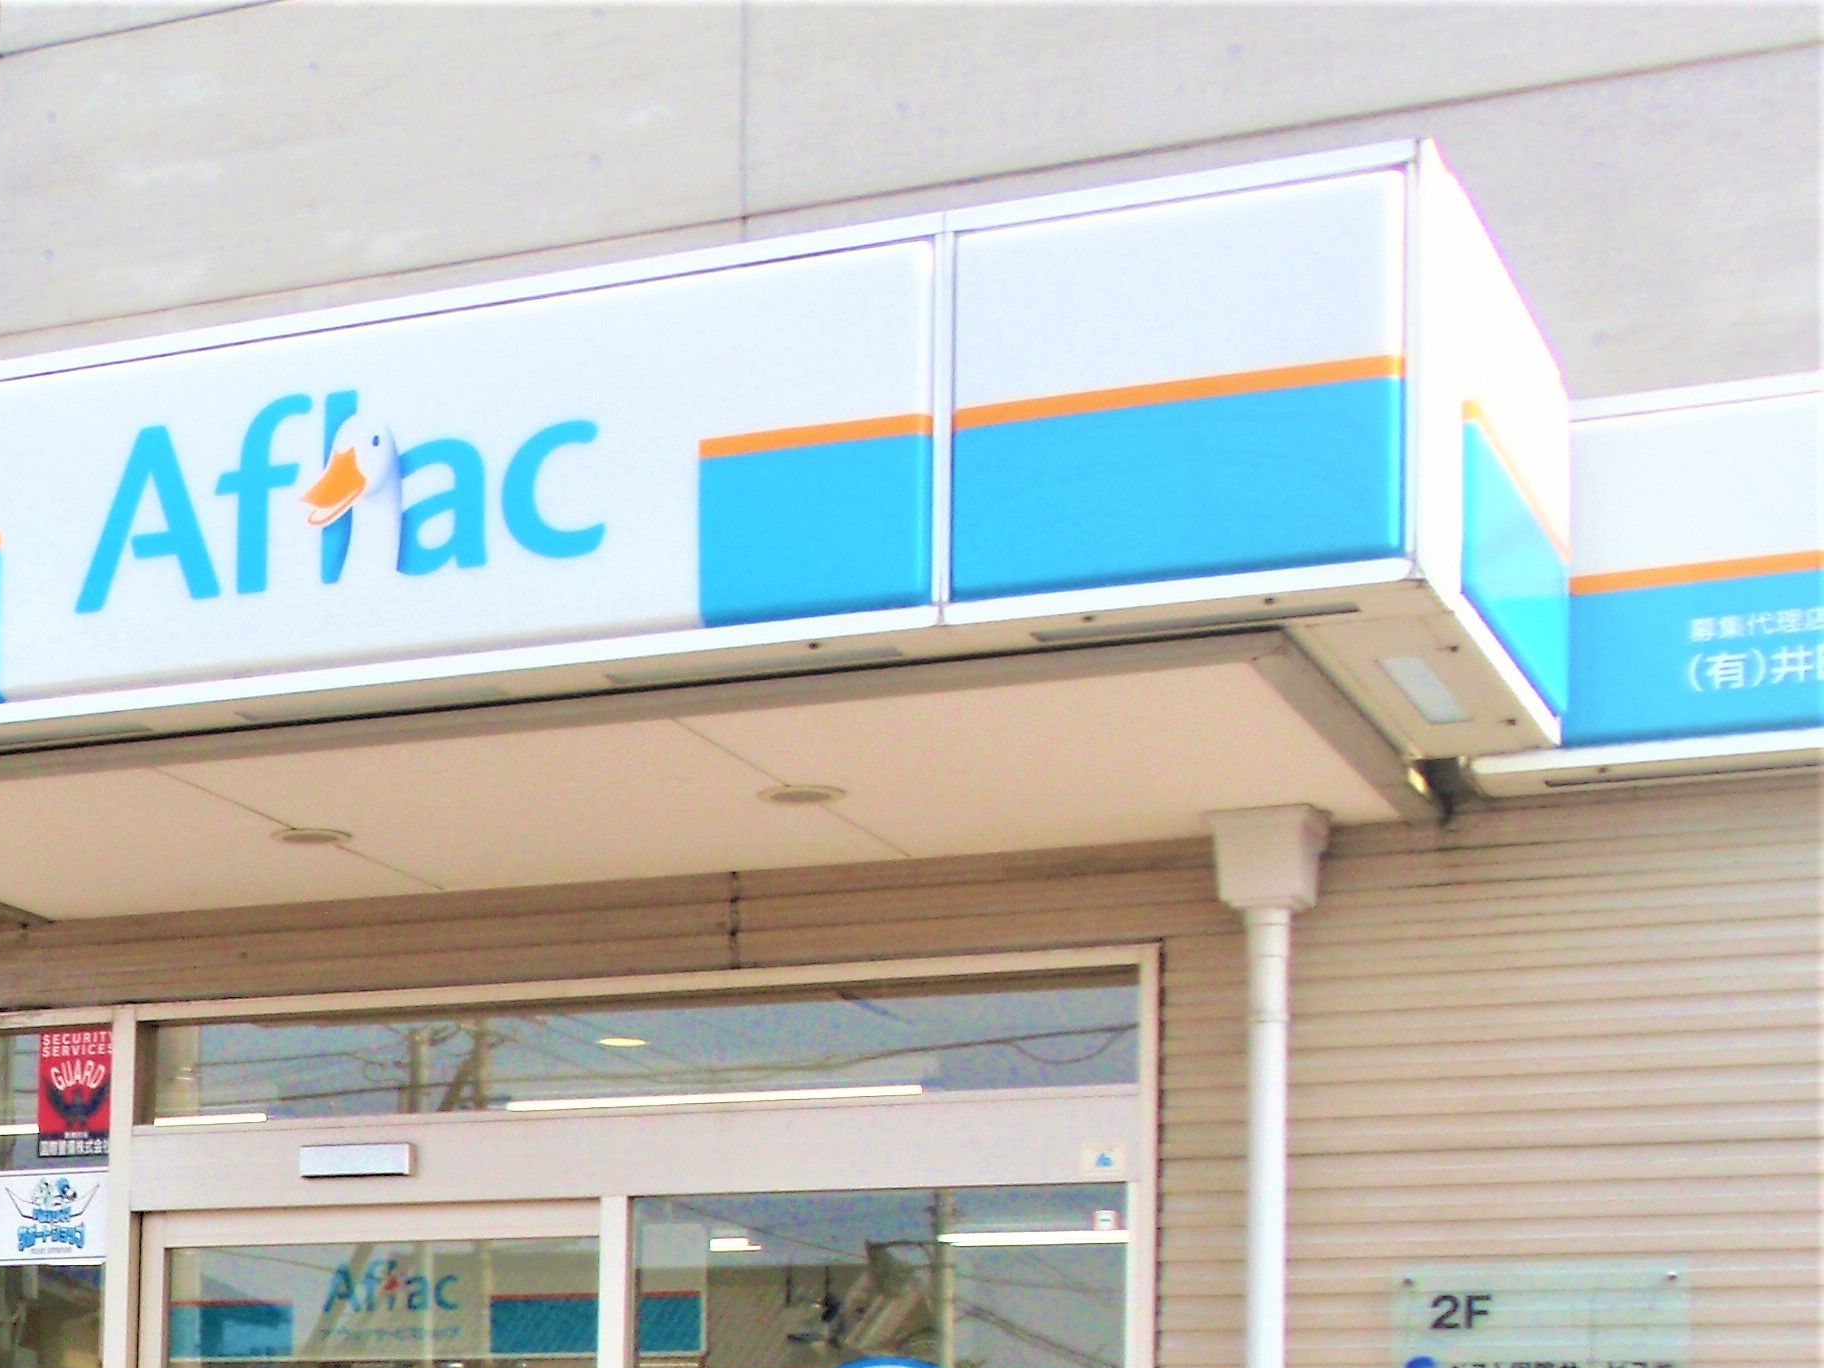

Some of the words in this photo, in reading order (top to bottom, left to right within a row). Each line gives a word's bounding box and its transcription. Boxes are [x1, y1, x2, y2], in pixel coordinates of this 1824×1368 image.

[74, 388, 607, 614] Aflac
[50, 1059, 106, 1091] GUARD
[1430, 1293, 1492, 1331] 2F
